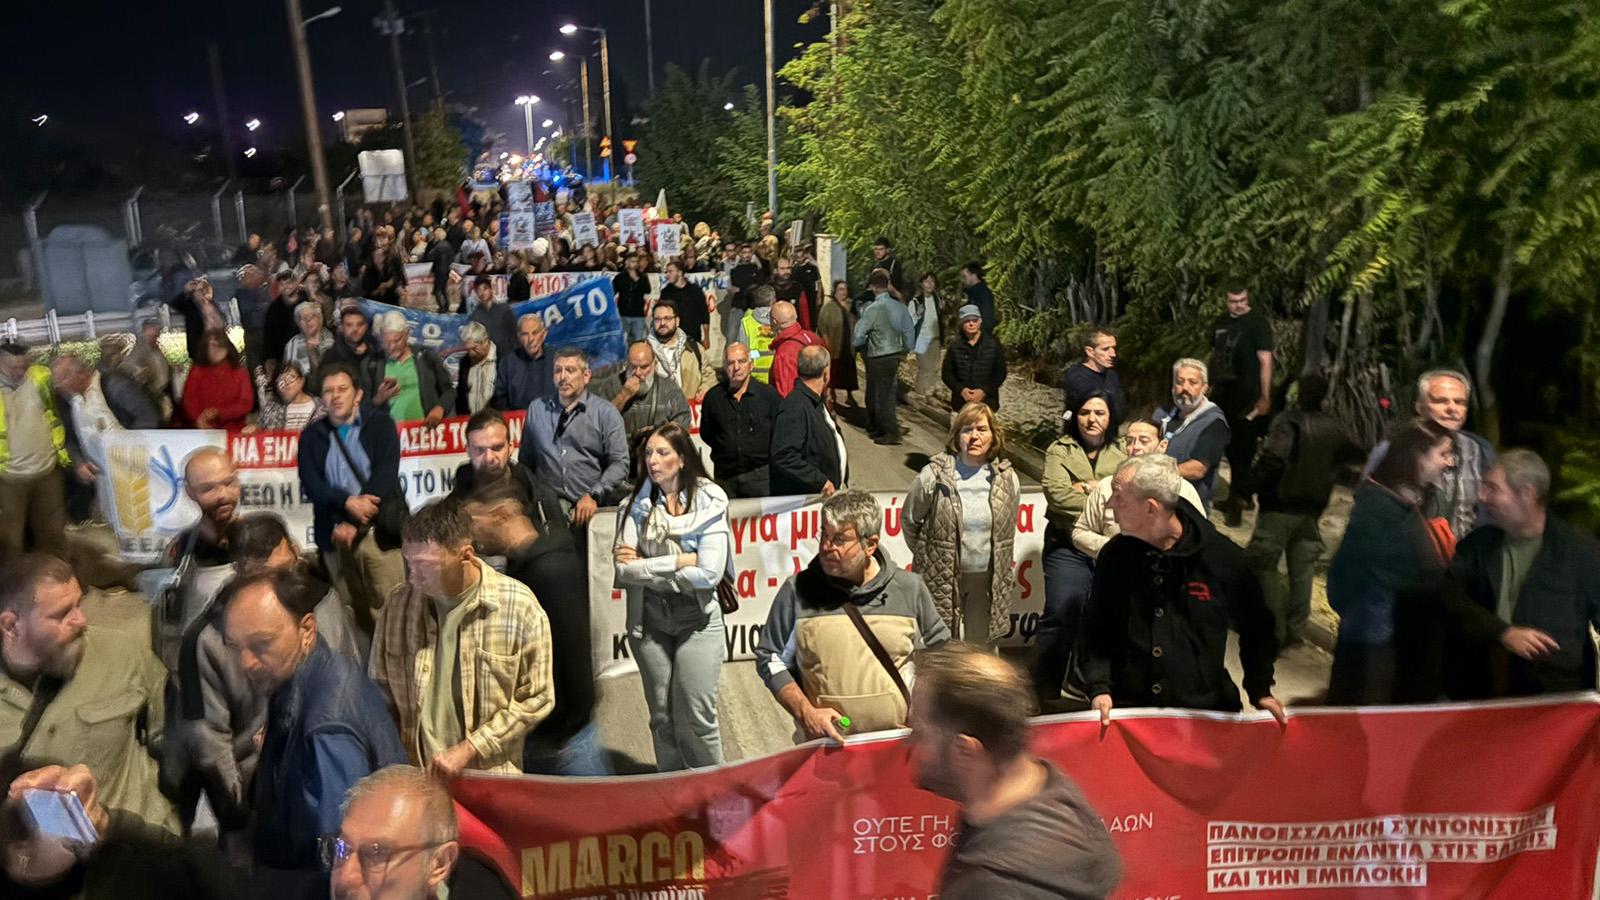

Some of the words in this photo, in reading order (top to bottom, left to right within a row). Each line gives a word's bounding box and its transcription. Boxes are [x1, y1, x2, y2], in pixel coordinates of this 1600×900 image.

[232, 436, 260, 464] ΝΑ
[262, 435, 299, 462] ΞΗΛ
[400, 423, 448, 452] ΑΣΕΙΣ
[731, 511, 778, 555] για
[853, 816, 914, 835] ΟΥΤΕ
[853, 834, 925, 854] ΣΤΟΥΣ
[1210, 846, 1320, 864] ΕΠΙΤΡΟΠΗ
[1326, 842, 1424, 863] ΕΝΑΝΤΙΑ
[1431, 842, 1479, 860] ΣΤΙΣ
[521, 830, 705, 897] MARCO
[1213, 870, 1250, 888] ΚΑΙ
[1256, 868, 1300, 886] ΤΗΝ
[1306, 866, 1422, 884] ΕΜΠΛΟΚΗ
